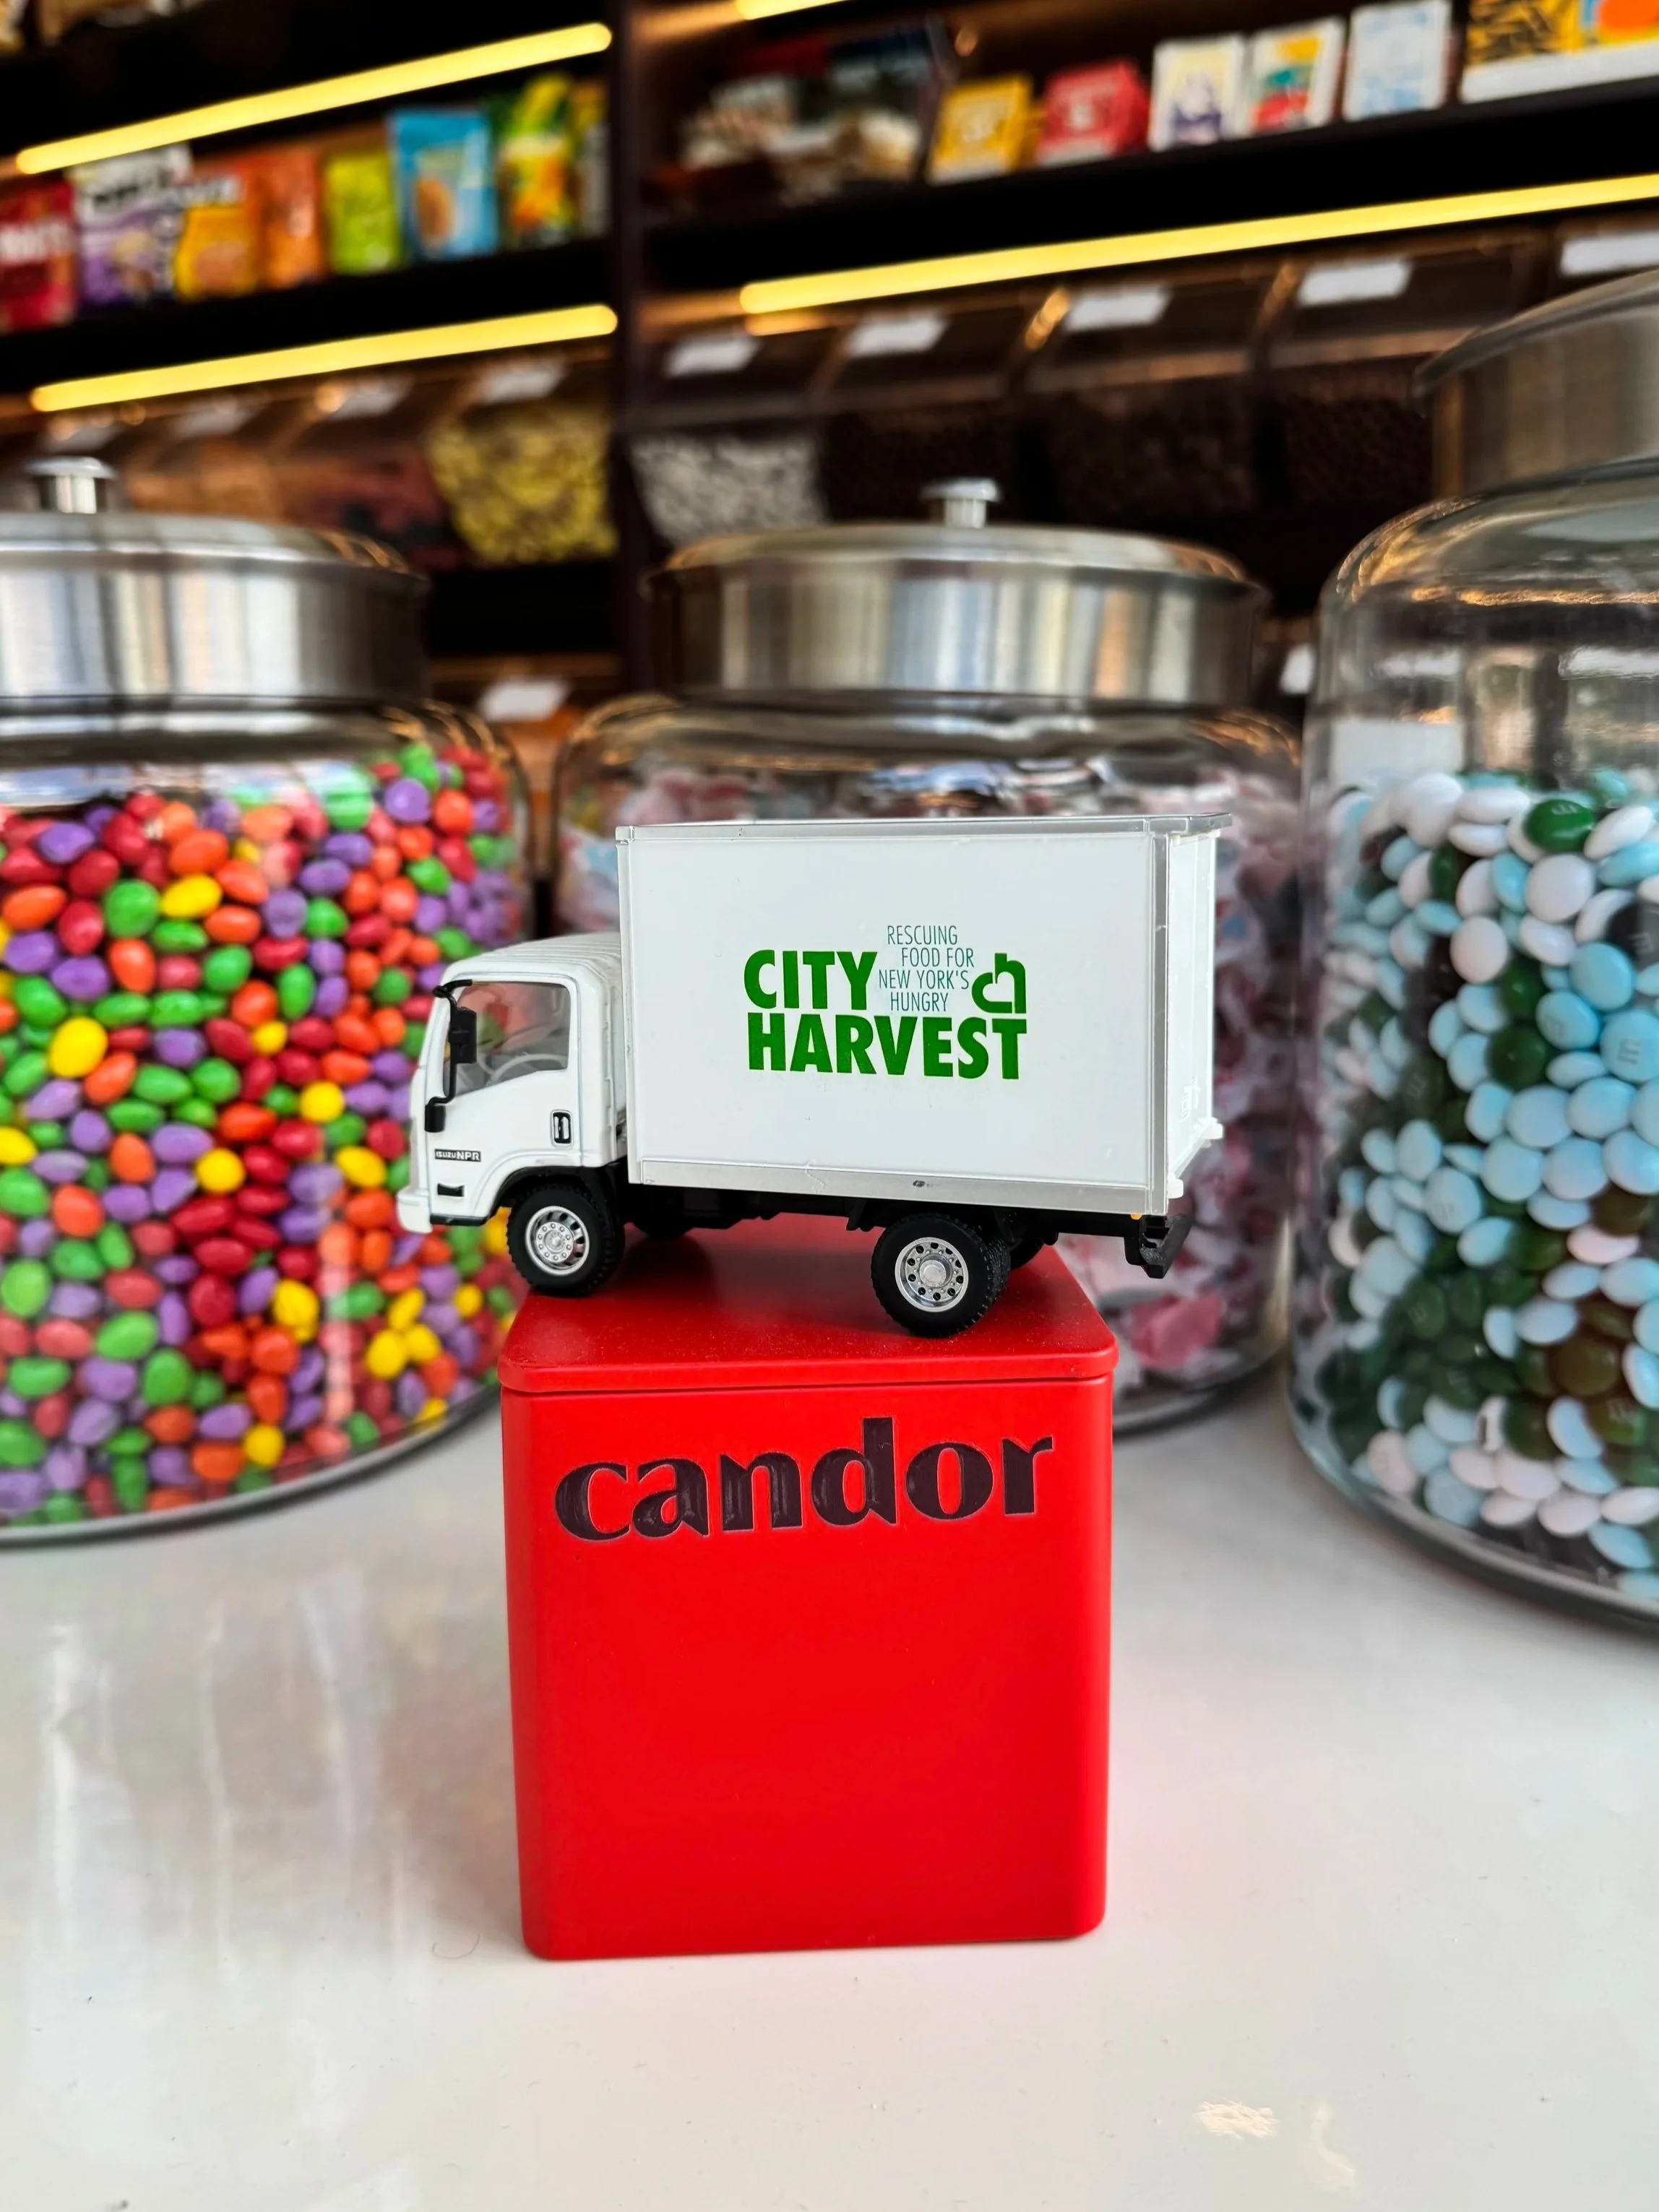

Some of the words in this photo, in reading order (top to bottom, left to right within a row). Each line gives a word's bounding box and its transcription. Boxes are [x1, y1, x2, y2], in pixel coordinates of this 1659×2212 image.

[887, 925, 957, 946] RESCUING
[901, 947, 940, 967] FOOD
[947, 948, 975, 968] FOR
[744, 949, 878, 1011] CITY
[879, 969, 911, 989] NEW
[916, 969, 970, 990] YORK'S
[890, 991, 949, 1012] HUNGRY
[747, 1012, 1027, 1080] HARVEST
[554, 1417, 1053, 1541] candor
